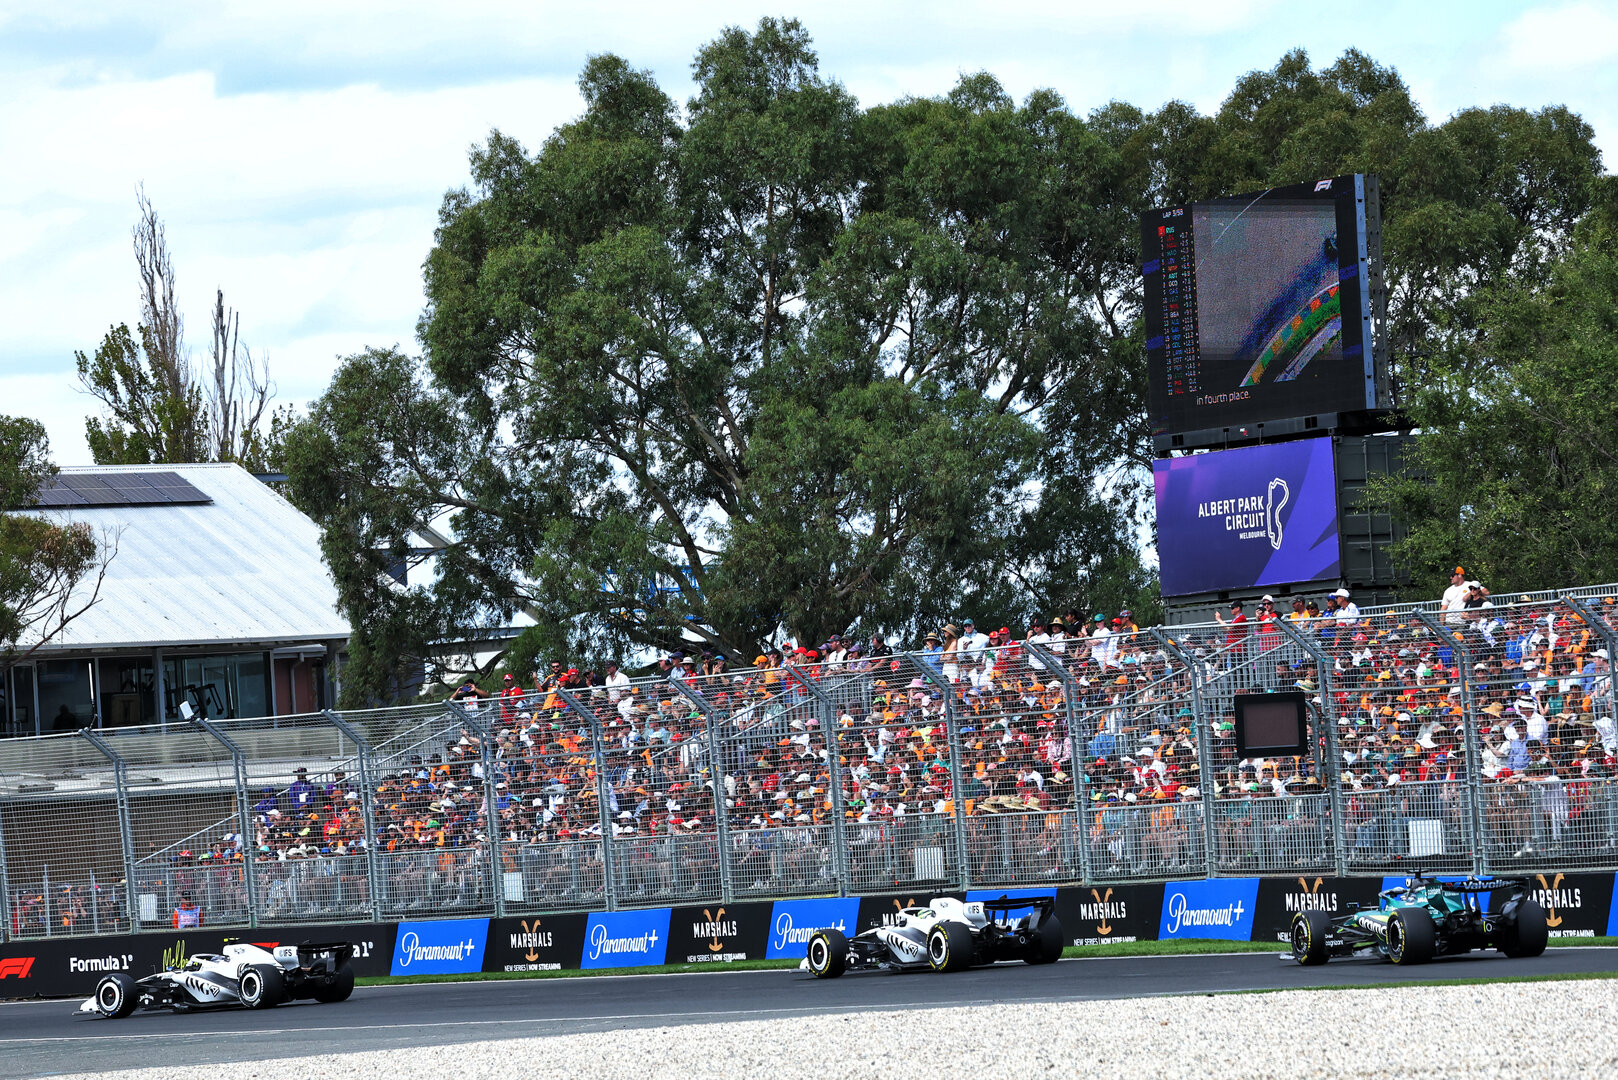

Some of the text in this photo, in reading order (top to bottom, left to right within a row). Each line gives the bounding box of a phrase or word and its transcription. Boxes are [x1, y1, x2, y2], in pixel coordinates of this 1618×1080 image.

[1196, 396, 1204, 406] in
[1204, 394, 1228, 405] fourth
[1198, 496, 1265, 518] ALBERT PARK
[1225, 512, 1265, 531] CIRCUIT
[1239, 530, 1266, 540] MELBOURNE
[1080, 901, 1127, 920] MARSHALS
[1285, 892, 1338, 912] MARSHALS
[1167, 893, 1245, 934] Paramount+
[693, 920, 737, 939] MARSHALS
[400, 932, 475, 967] Paramount+
[510, 931, 553, 949] MARSHALS
[589, 924, 659, 960] Paramount+
[70, 955, 120, 973] Formula
